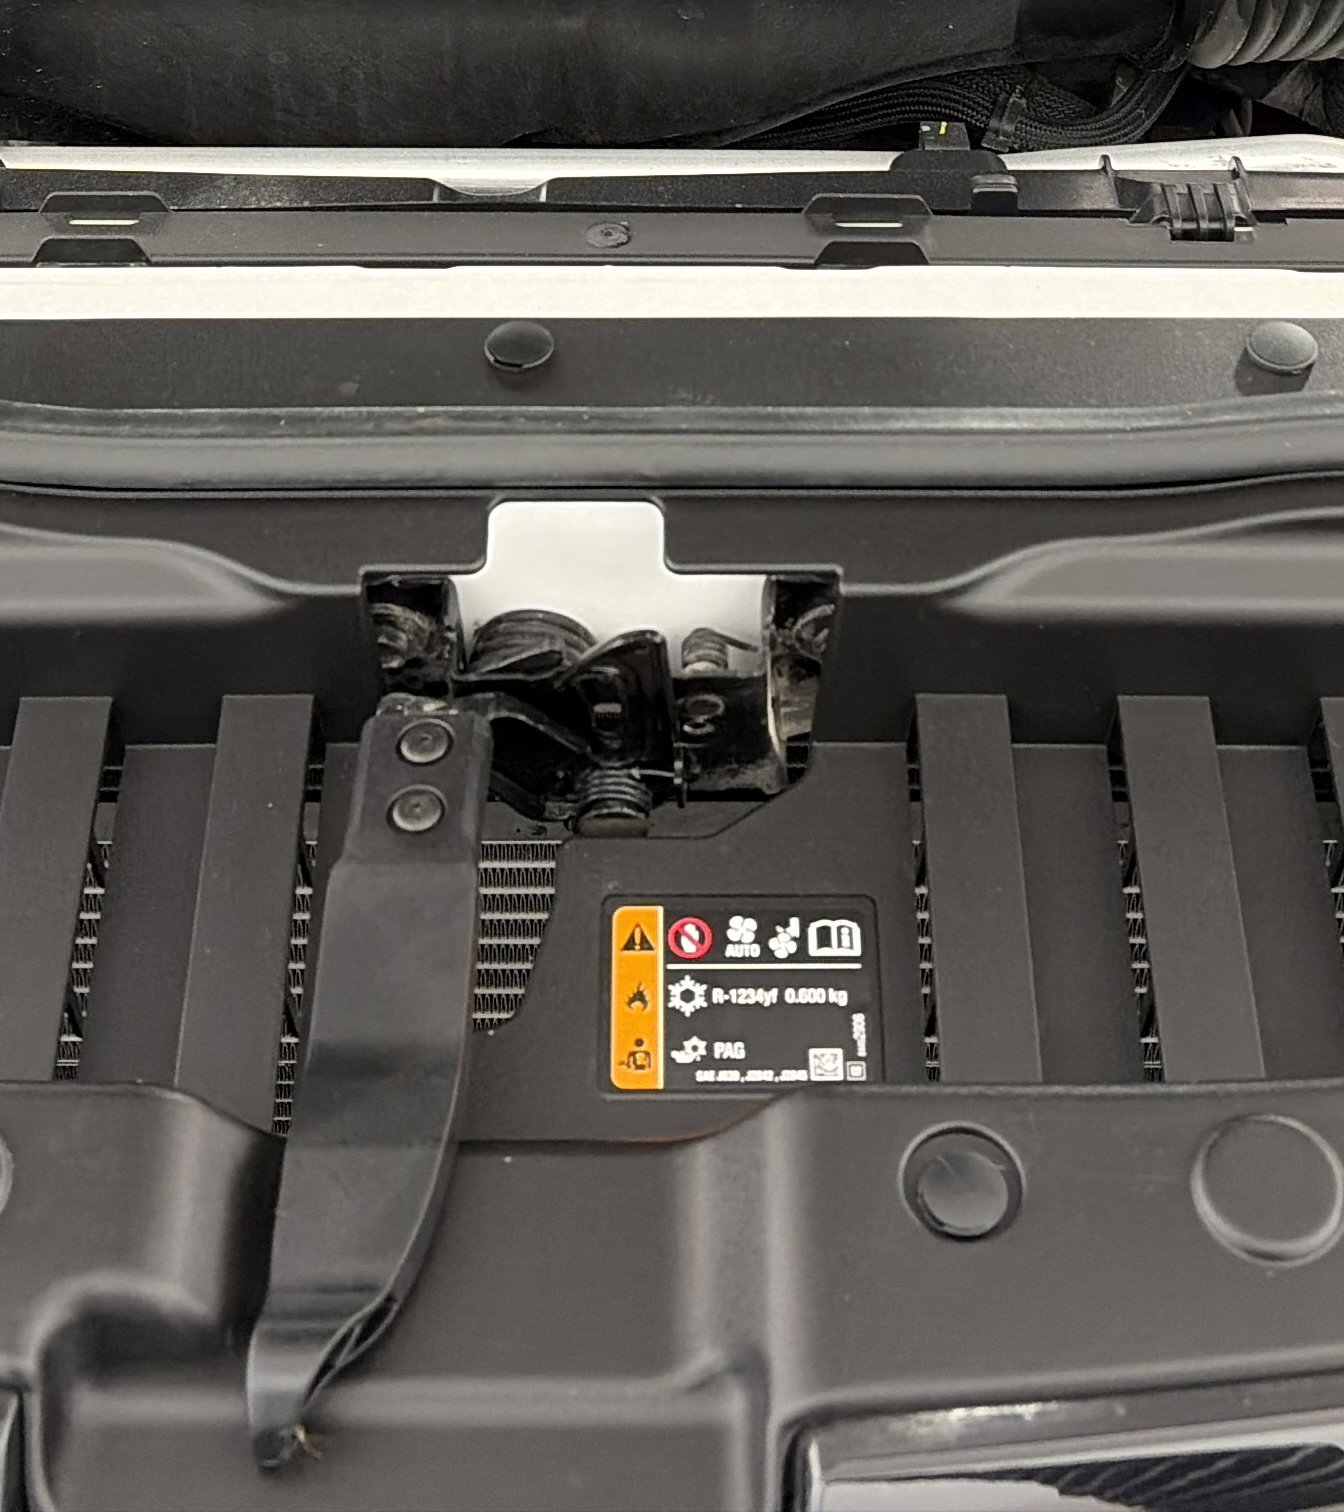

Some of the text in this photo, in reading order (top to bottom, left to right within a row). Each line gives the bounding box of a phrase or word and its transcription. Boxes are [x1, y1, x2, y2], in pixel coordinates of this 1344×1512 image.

[725, 944, 761, 958] AUTO
[712, 988, 779, 1007] R-1234yf
[828, 988, 848, 1007] kg
[714, 1042, 745, 1059] PAG
